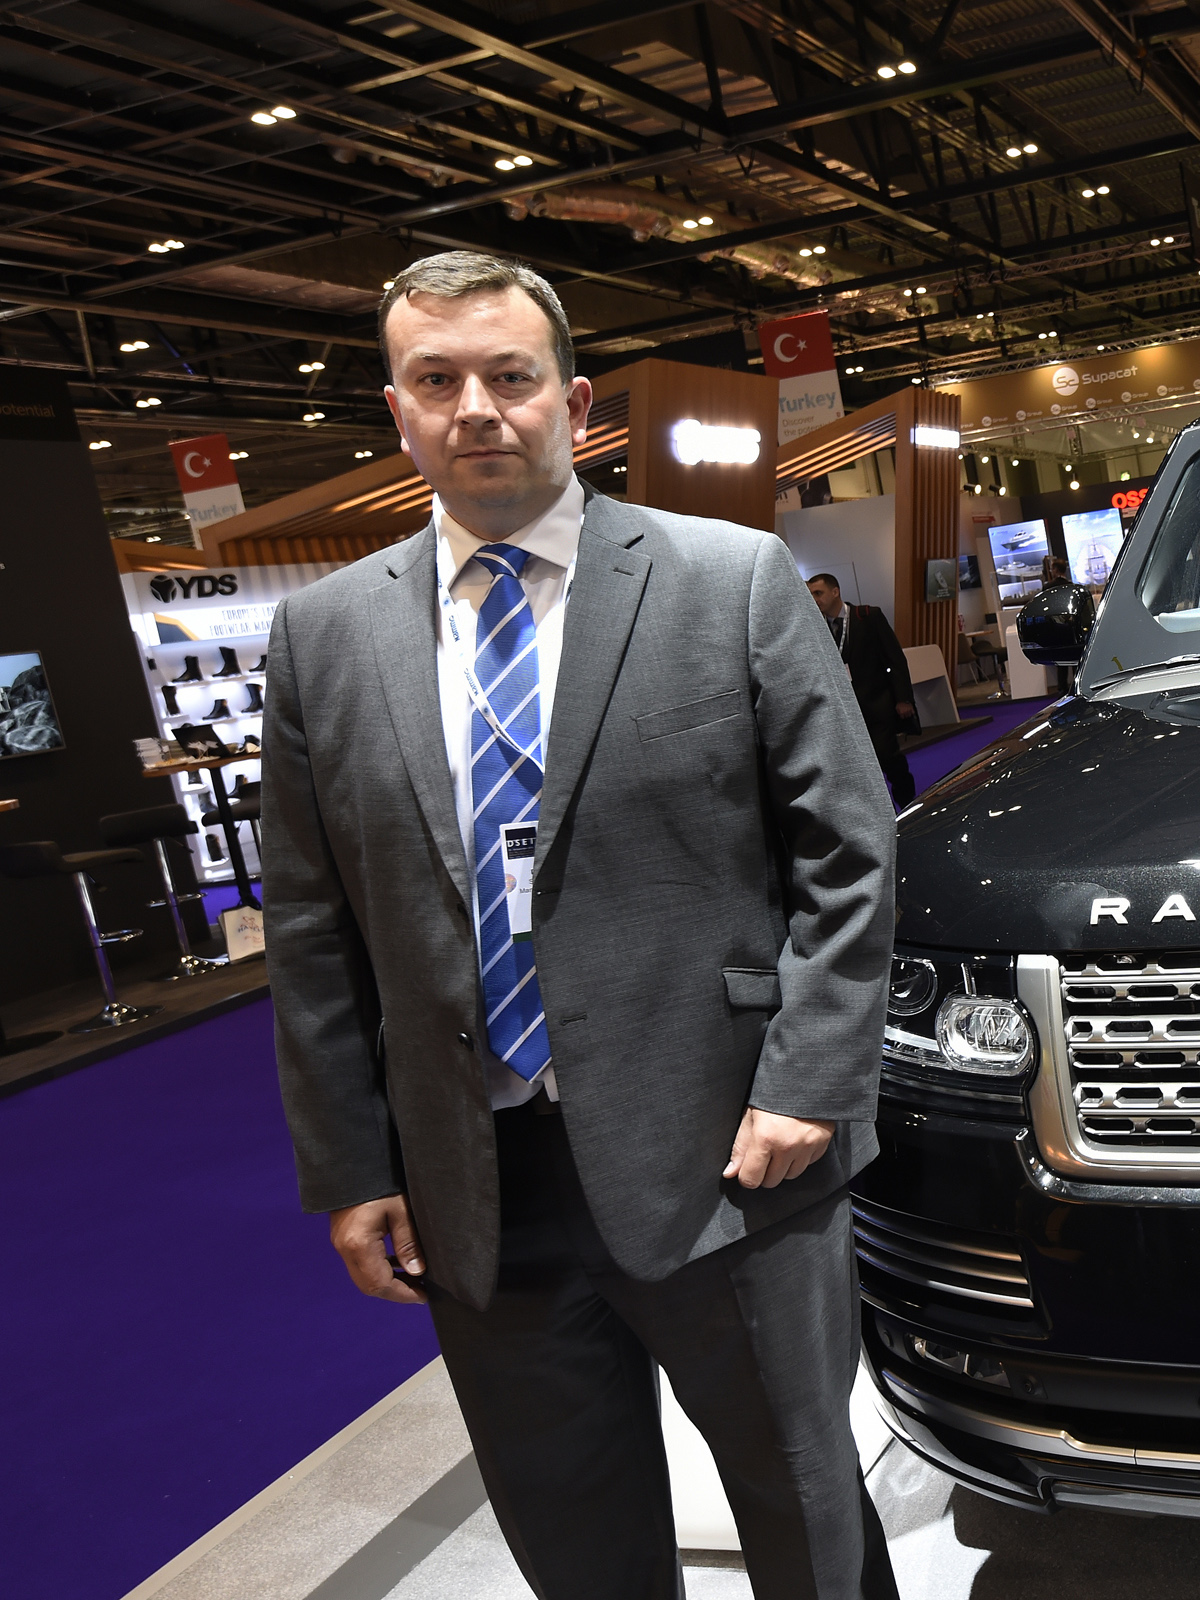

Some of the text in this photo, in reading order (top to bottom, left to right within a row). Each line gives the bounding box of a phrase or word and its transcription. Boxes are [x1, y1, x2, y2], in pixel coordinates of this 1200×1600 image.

[1081, 364, 1139, 385] Supacat
[0, 402, 56, 418] otential
[779, 392, 836, 413] Turkey
[189, 503, 238, 522] Turkey
[174, 573, 239, 600] YDS
